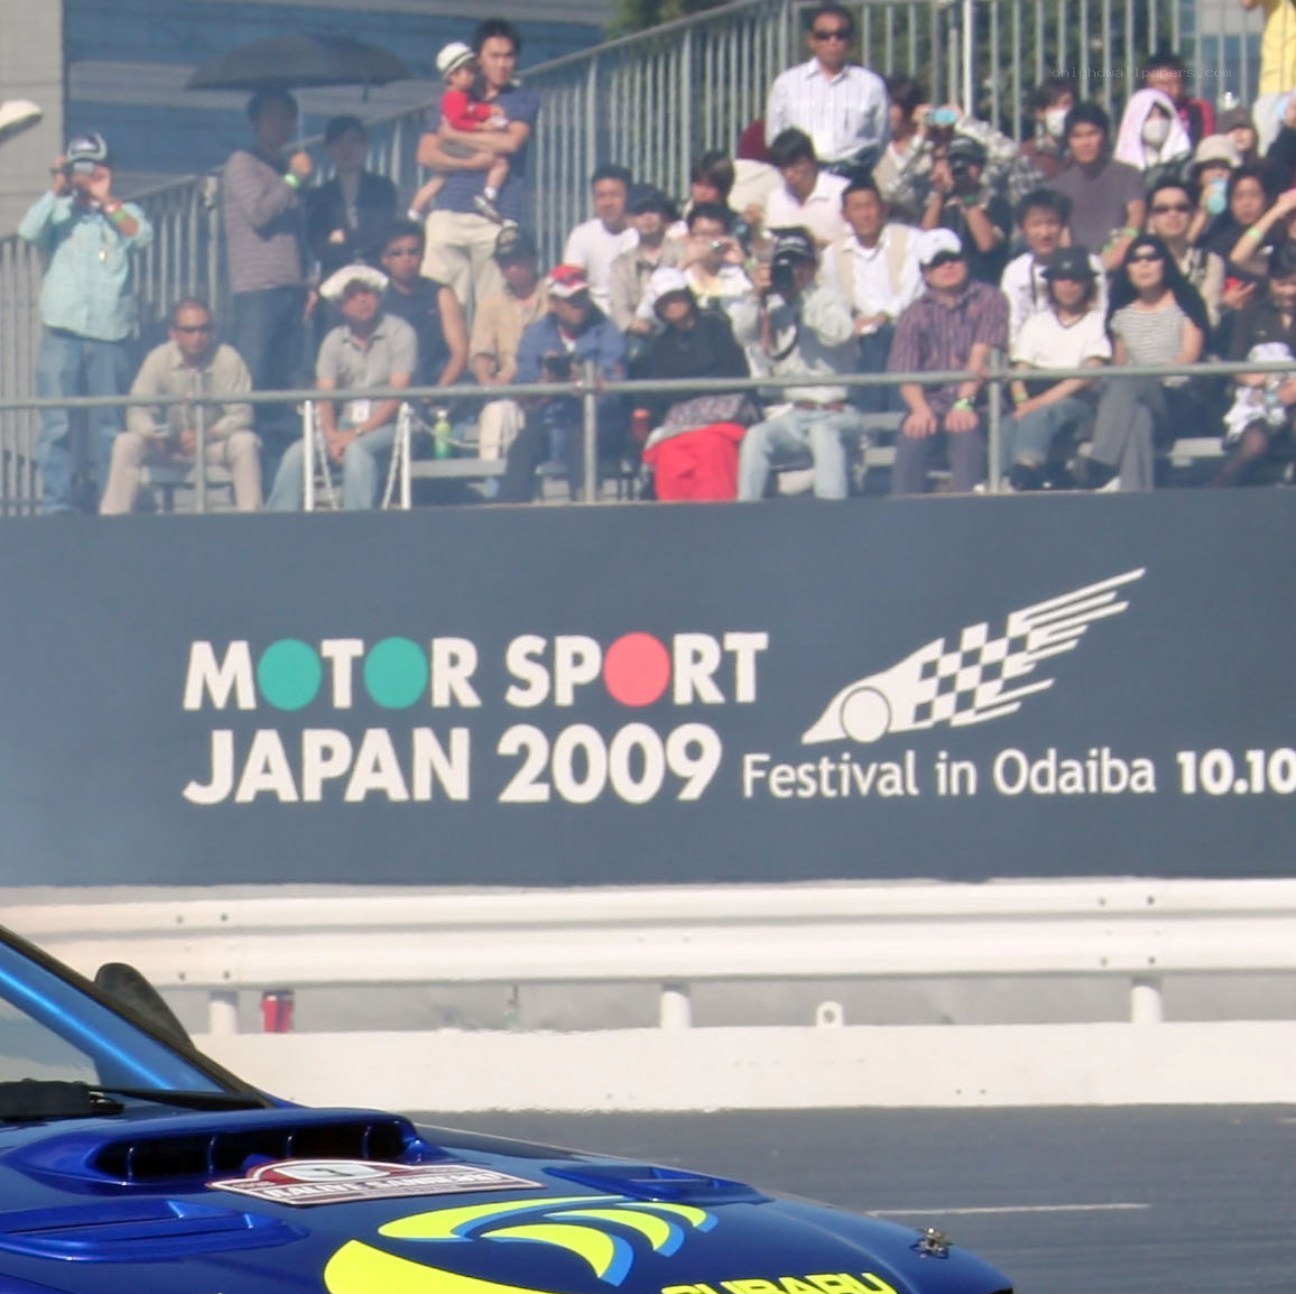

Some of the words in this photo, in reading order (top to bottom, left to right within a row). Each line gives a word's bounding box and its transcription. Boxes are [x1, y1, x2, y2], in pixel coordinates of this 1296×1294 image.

[183, 636, 482, 711] MOTOR
[505, 632, 769, 707] SPORT
[182, 727, 470, 804] JAPAN
[497, 723, 722, 803] 2009
[742, 750, 919, 798] Festival
[935, 751, 976, 795] in
[993, 747, 1156, 795] Odaiba
[1177, 748, 1296, 795] 10.10
